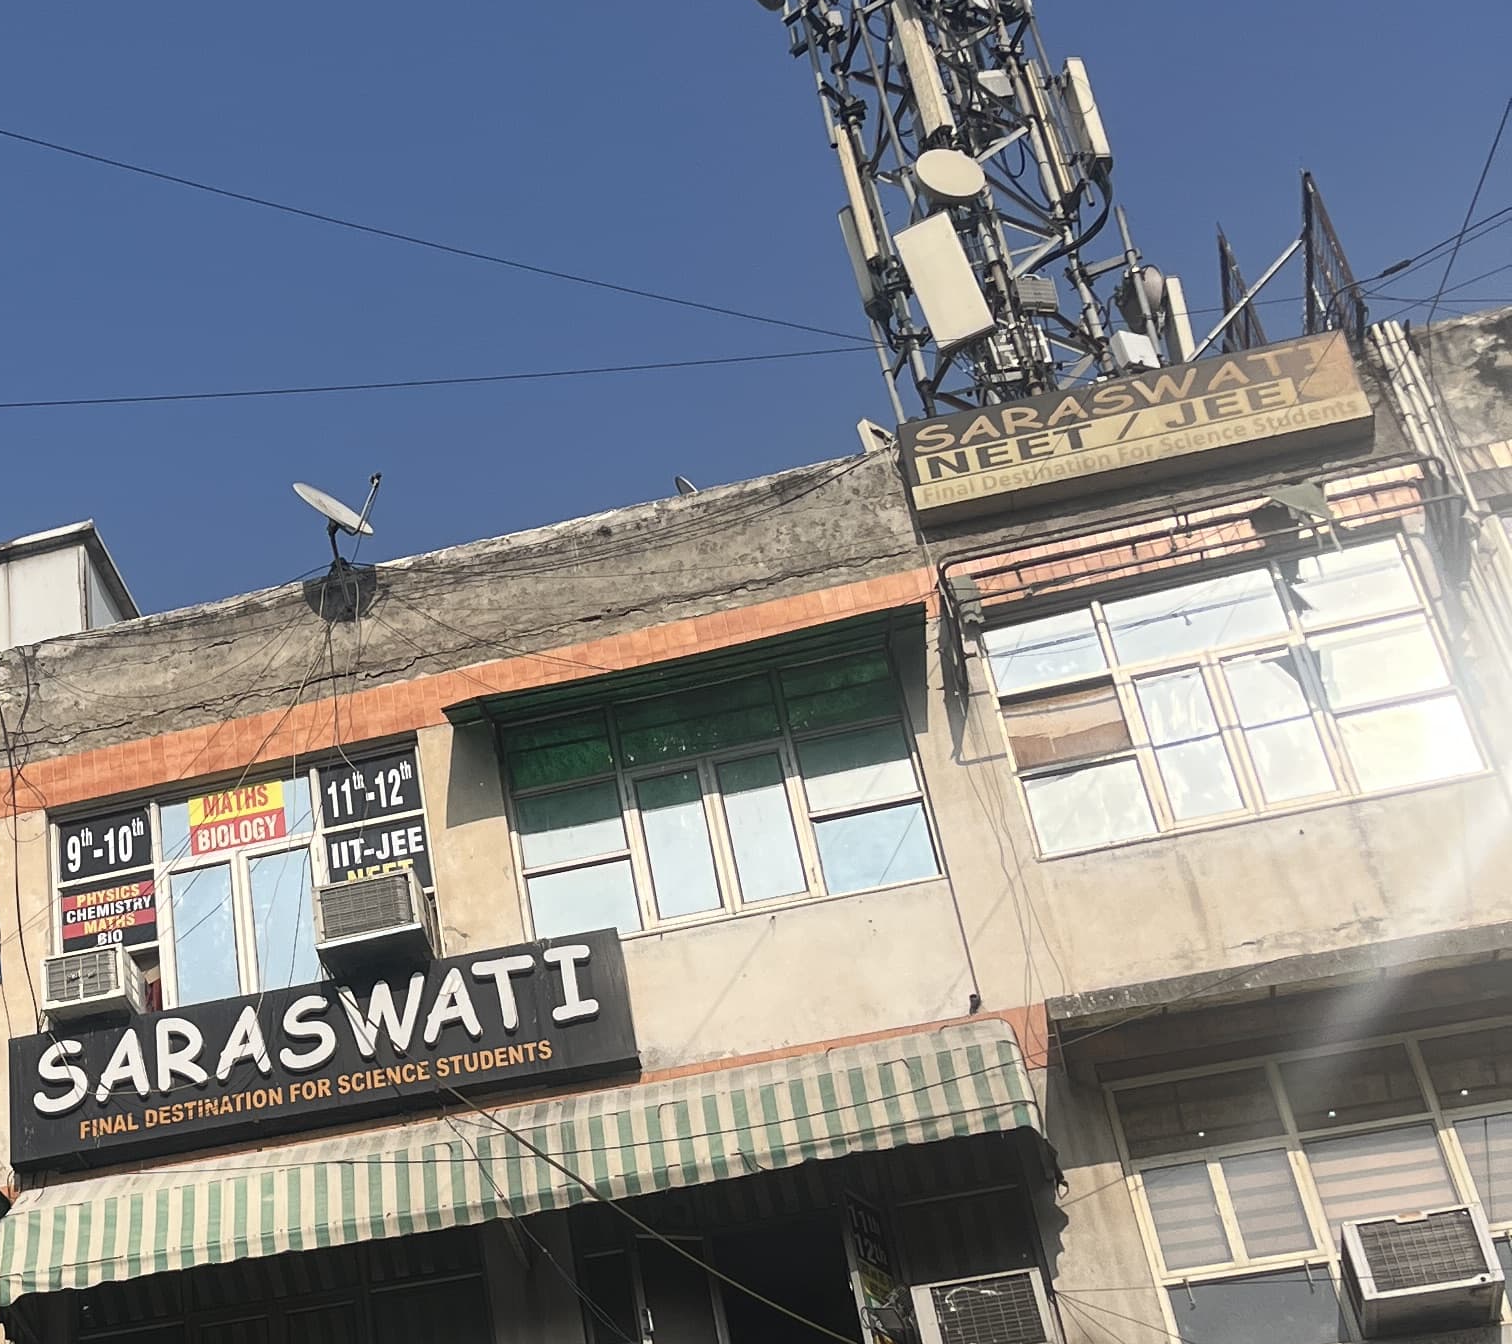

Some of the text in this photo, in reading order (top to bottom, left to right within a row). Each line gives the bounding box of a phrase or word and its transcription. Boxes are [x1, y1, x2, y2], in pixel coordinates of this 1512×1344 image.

[927, 382, 1288, 479] NEET JEE
[923, 399, 1358, 504] Final Destination For Science Students
[202, 784, 268, 817] MATHS
[67, 816, 144, 873] 9th-10th
[198, 814, 277, 851] BIOLOGY
[331, 826, 424, 869] IIT-JEE
[67, 895, 151, 923] CHEMISTRY
[76, 884, 139, 907] PHYSICS
[84, 913, 135, 935] MATHS
[97, 929, 123, 946] BIO
[32, 944, 599, 1117] SARASWATI
[79, 1039, 553, 1140] FINAL DESTINATION FOR SCIENCE STUDENTS
